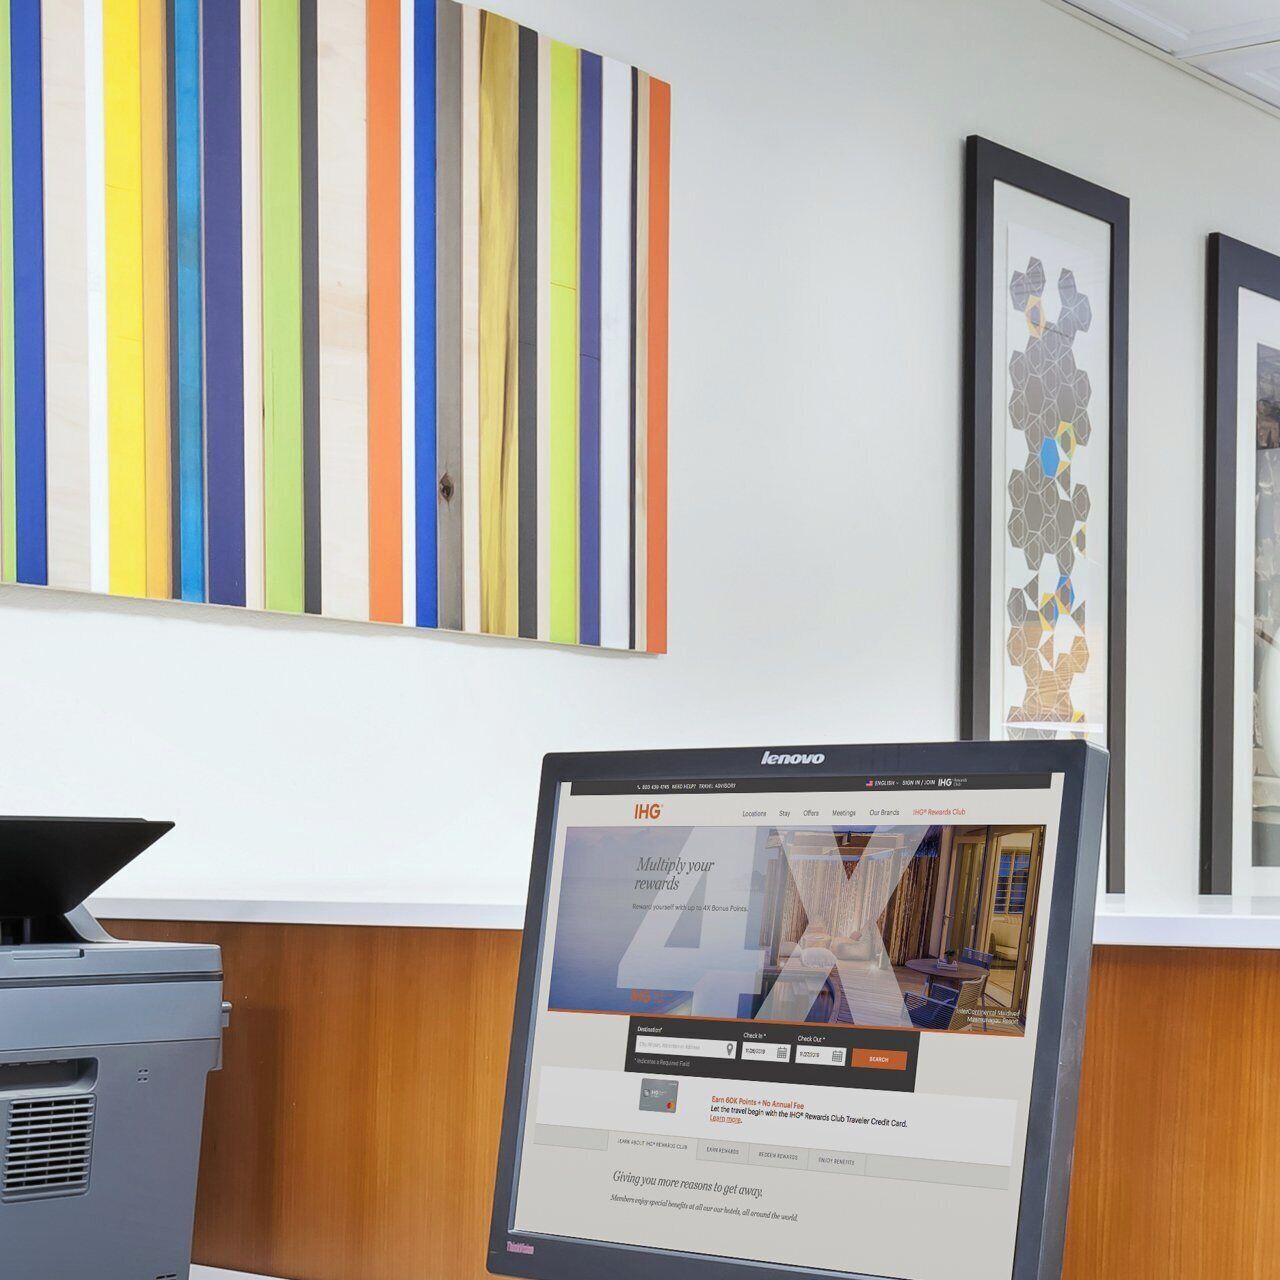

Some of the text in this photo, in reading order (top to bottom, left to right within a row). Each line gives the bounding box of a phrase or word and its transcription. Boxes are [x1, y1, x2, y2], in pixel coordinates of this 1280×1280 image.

[761, 751, 825, 765] lenovo
[937, 778, 952, 787] IHG
[779, 810, 790, 818] Stay
[803, 809, 819, 817] Offers
[832, 809, 856, 818] Meetings
[928, 808, 951, 816] Rewards
[952, 808, 966, 816] Club
[636, 856, 716, 875] Multiply your
[634, 876, 680, 890] rewards
[653, 903, 675, 911] yourself
[725, 1096, 738, 1104] 60K
[739, 1097, 757, 1106] Points
[762, 1099, 771, 1107] No
[771, 1100, 793, 1109] Annual
[793, 1102, 805, 1110] Fee
[710, 1104, 720, 1112] Let
[731, 1106, 747, 1115] travel
[748, 1107, 764, 1117] begin
[765, 1109, 777, 1117] with
[778, 1110, 788, 1118] the
[804, 1112, 829, 1122] Rewards
[831, 1114, 845, 1123] Club
[846, 1115, 870, 1125] Traveler
[871, 1117, 890, 1126] Credit
[891, 1119, 908, 1128] Card.
[710, 1114, 726, 1122] Learn
[612, 1170, 763, 1199] Giving you more reasons to get away.
[610, 1193, 635, 1203] Members
[635, 1197, 649, 1206] enjoy
[649, 1199, 668, 1207] special
[668, 1200, 688, 1209] benefits
[742, 1208, 750, 1217] all
[750, 1210, 771, 1219] around
[771, 1212, 781, 1220] the
